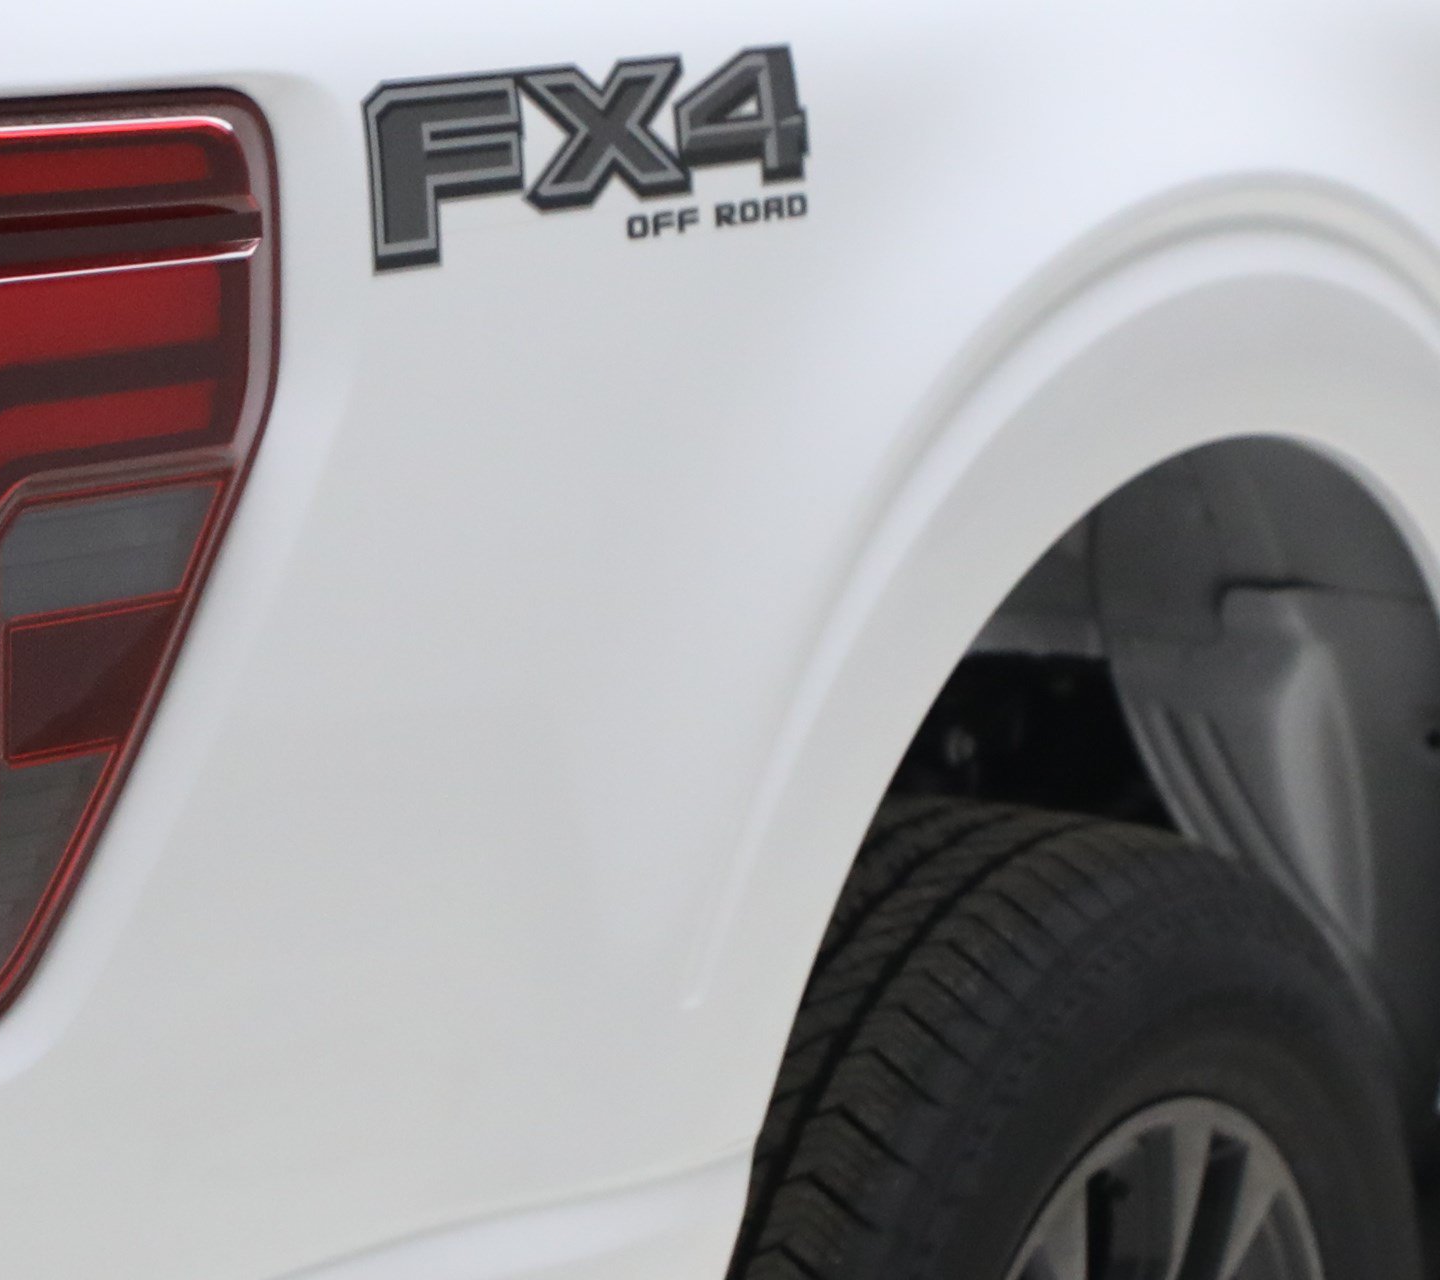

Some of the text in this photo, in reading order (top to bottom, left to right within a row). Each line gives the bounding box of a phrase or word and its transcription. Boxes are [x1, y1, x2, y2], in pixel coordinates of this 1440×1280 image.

[361, 42, 809, 276] FX4
[626, 192, 808, 241] OFF ROAD
